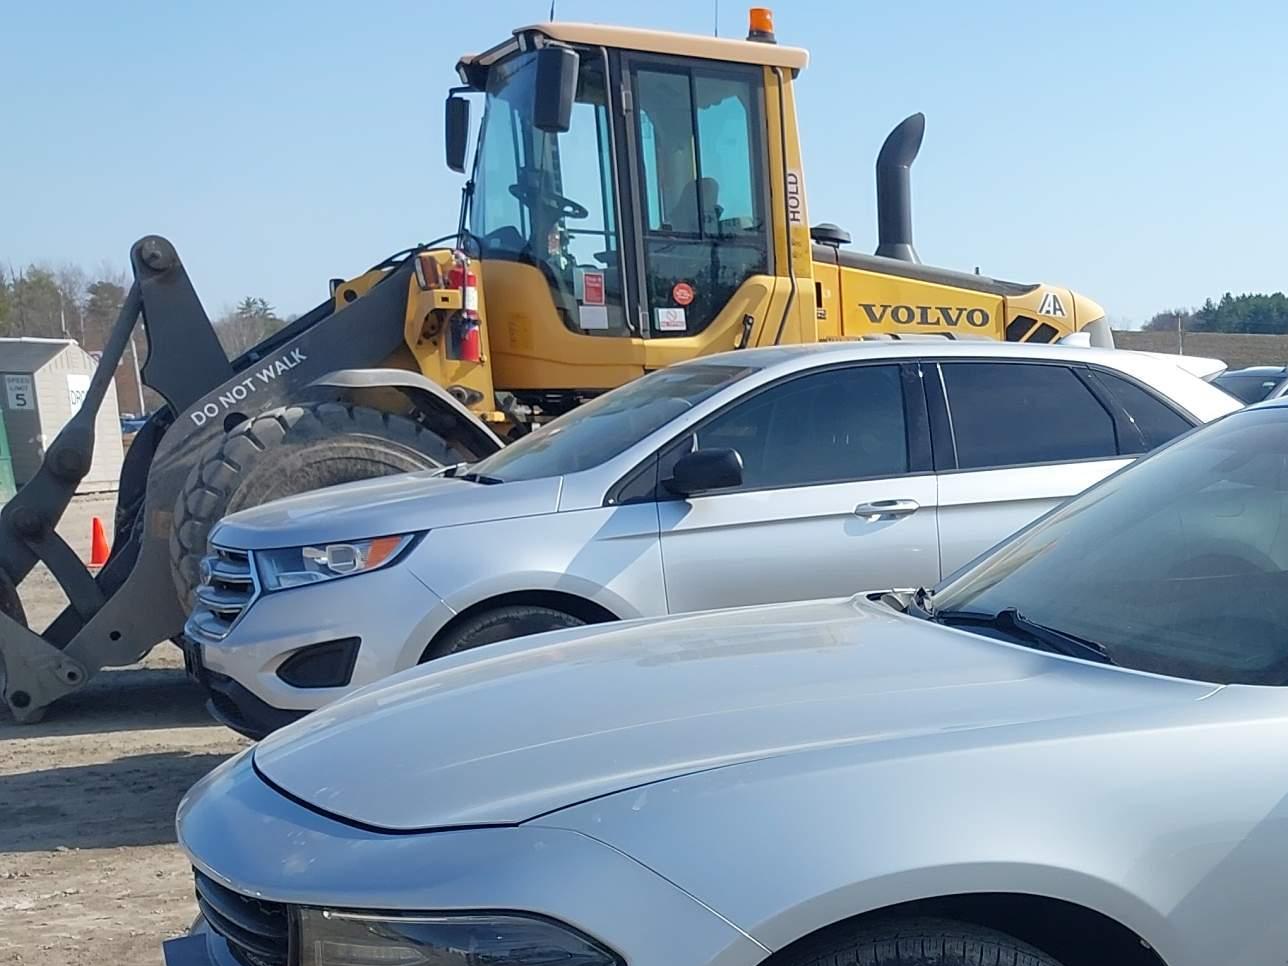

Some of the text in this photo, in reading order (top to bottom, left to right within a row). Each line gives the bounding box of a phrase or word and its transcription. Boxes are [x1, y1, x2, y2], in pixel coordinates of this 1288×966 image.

[788, 172, 801, 222] HOLD
[858, 303, 990, 328] VOLVO
[15, 393, 27, 407] 5
[191, 348, 307, 426] DO NOT WALK
